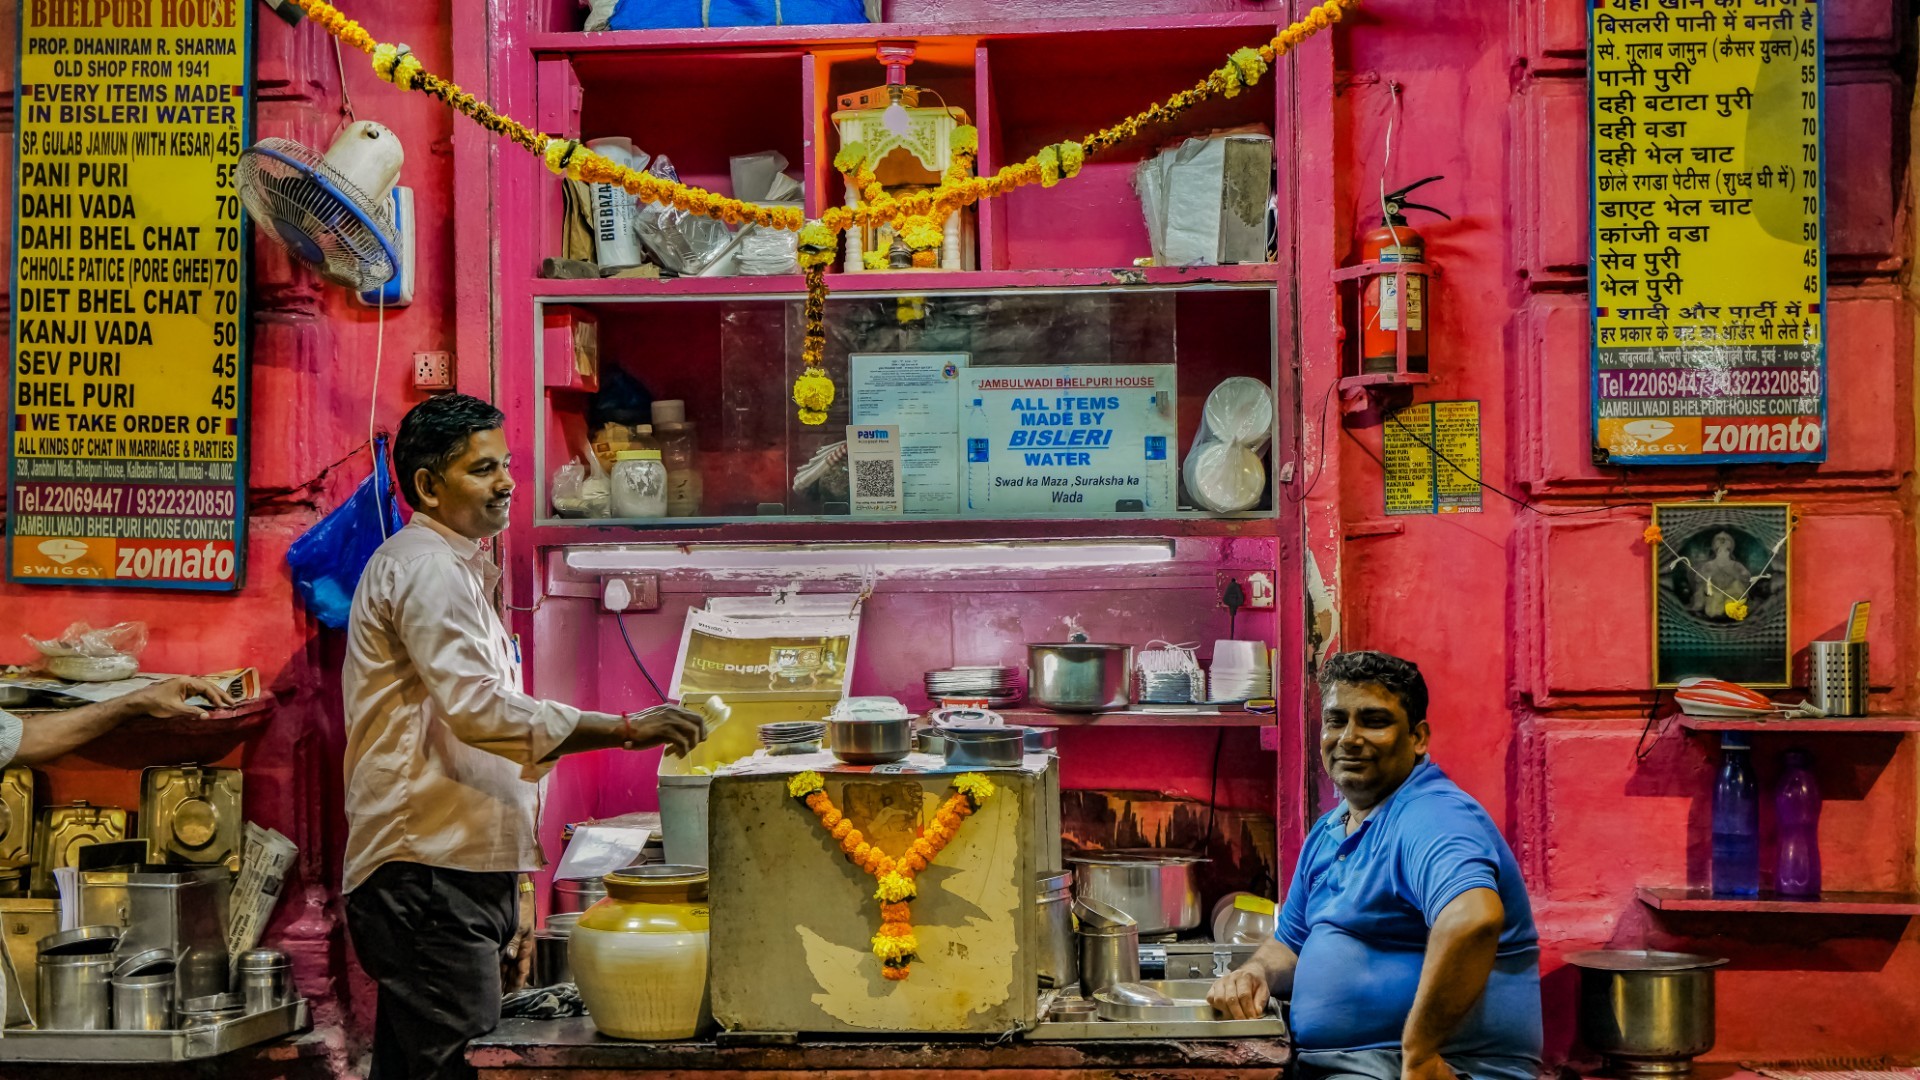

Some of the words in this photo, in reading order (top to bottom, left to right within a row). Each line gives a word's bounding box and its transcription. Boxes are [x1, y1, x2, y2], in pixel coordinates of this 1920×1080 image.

[30, 0, 152, 27] BHELPURI
[161, 0, 236, 27] HOUSE
[1598, 12, 1669, 34] बिसलरी
[1676, 11, 1716, 31] पानी
[1723, 10, 1736, 31] में
[1744, 9, 1794, 30] बनती
[1800, 8, 1813, 31] है
[29, 38, 67, 54] PROP.
[74, 39, 152, 55] DHANIRAM
[157, 39, 170, 55] R.
[175, 39, 236, 55] SHARMA
[1626, 43, 1663, 65] गुलाब
[1668, 42, 1707, 65] जामुन
[1801, 39, 1814, 57] 45
[54, 61, 82, 77] OLD
[88, 61, 126, 77] SHOP
[132, 61, 172, 77] FROM
[178, 61, 209, 77] 1941
[1598, 63, 1646, 86] पानी
[1654, 62, 1691, 92] पुरी
[1801, 66, 1815, 83] 55
[34, 85, 99, 102] EVERY
[107, 85, 167, 102] ITEMS
[175, 85, 231, 102] MADE
[1598, 90, 1636, 114] दही
[1644, 94, 1708, 111] बटाटा
[1716, 87, 1753, 117] पुरी
[1802, 92, 1816, 109] 70
[28, 106, 49, 123] IN
[60, 106, 147, 123] BISLERI
[156, 106, 235, 123] WATER
[1598, 116, 1636, 140] दही
[1644, 121, 1686, 137] वडा
[1802, 118, 1816, 135] 70
[22, 132, 38, 155] SP.
[43, 132, 82, 155] GULAB
[86, 132, 127, 155] JAMUN
[132, 132, 166, 160] (WITH
[172, 132, 214, 160] KESAR)
[216, 133, 239, 156] 45
[1599, 143, 1636, 166] दही
[1645, 143, 1683, 164] भेल
[1691, 147, 1734, 163] चाट
[1803, 144, 1816, 161] 70
[22, 163, 69, 187] PANI
[78, 163, 127, 187] PURI
[216, 164, 237, 188] 55
[22, 194, 71, 218] DAHI
[79, 195, 135, 218] VADA
[216, 196, 238, 219] 70
[1599, 201, 1655, 220] डाएट
[1664, 194, 1702, 216] भेल
[1710, 199, 1753, 215] चाट
[1803, 197, 1816, 214] 70
[21, 226, 71, 249] DAHI
[80, 226, 135, 250] BHEL
[143, 227, 200, 251] CHAT
[215, 227, 238, 251] 70
[600, 220, 615, 241] BIG
[1600, 221, 1659, 243] कांजी
[1667, 226, 1709, 242] वडा
[1803, 223, 1817, 240] 50
[21, 257, 74, 281] CHHOLE
[79, 258, 124, 281] PATICE
[129, 258, 168, 289] (PORE
[173, 259, 212, 289] GHEE)
[215, 259, 237, 283] 70
[1600, 248, 1636, 269] सेव
[1645, 246, 1680, 276] पुरी
[1804, 249, 1817, 266] 45
[1601, 274, 1639, 296] भेल
[1647, 272, 1683, 302] पुरी
[1804, 276, 1817, 293] 45
[21, 289, 70, 312] DIET
[78, 289, 135, 313] BHEL
[144, 290, 202, 314] CHAT
[214, 291, 237, 314] 70
[1617, 302, 1669, 320] शादी
[1679, 301, 1721, 319] और
[1729, 301, 1777, 319] पार्टी
[1786, 301, 1801, 318] में
[20, 320, 86, 344] KANJI
[95, 321, 152, 345] VADA
[214, 322, 236, 346] 50
[19, 350, 61, 375] SEV
[69, 352, 120, 376] PURI
[213, 354, 235, 378] 45
[978, 378, 1053, 388] JAMBULWADI
[1056, 378, 1112, 387] BHELPURI
[1116, 377, 1154, 386] HOUSE
[18, 383, 75, 406] BHEL
[83, 384, 134, 408] PURI
[212, 385, 235, 409] 45
[1011, 398, 1049, 411] ALL
[1057, 397, 1119, 410] ITEMS
[1600, 401, 1669, 417] JAMBULWADI
[1729, 400, 1765, 414] HOUSE
[1769, 399, 1819, 414] CONTACT
[31, 414, 59, 431] WE
[67, 414, 116, 432] TAKE
[124, 415, 189, 433] ORDER
[196, 417, 221, 434] OF
[1021, 413, 1073, 426] MADE
[1080, 413, 1104, 425] BY
[1009, 429, 1113, 447] BISLERI
[1703, 417, 1820, 452] zomato
[18, 438, 36, 454] ALL
[40, 438, 68, 455] KINDS
[72, 439, 84, 455] OF
[88, 439, 113, 456] CHAT
[116, 440, 126, 456] IN
[129, 440, 180, 457] MARRIAGE
[183, 441, 190, 457] &
[194, 441, 233, 458] PARTIES
[1025, 453, 1090, 466] WATER
[995, 477, 1023, 487] Swad
[1026, 477, 1038, 486] ka
[1041, 476, 1068, 487] Maza
[1127, 476, 1139, 486] ka
[16, 486, 122, 513] Tel.22069447
[126, 489, 132, 513] /
[137, 489, 234, 515] 9322320850
[1052, 491, 1083, 503] Wada
[15, 516, 84, 537] JAMBULWADI
[87, 517, 141, 538] BHELPURI
[144, 519, 180, 538] HOUSE
[184, 520, 234, 539] CONTACT
[23, 566, 103, 575] SWIGGY
[116, 542, 234, 580] zomato
